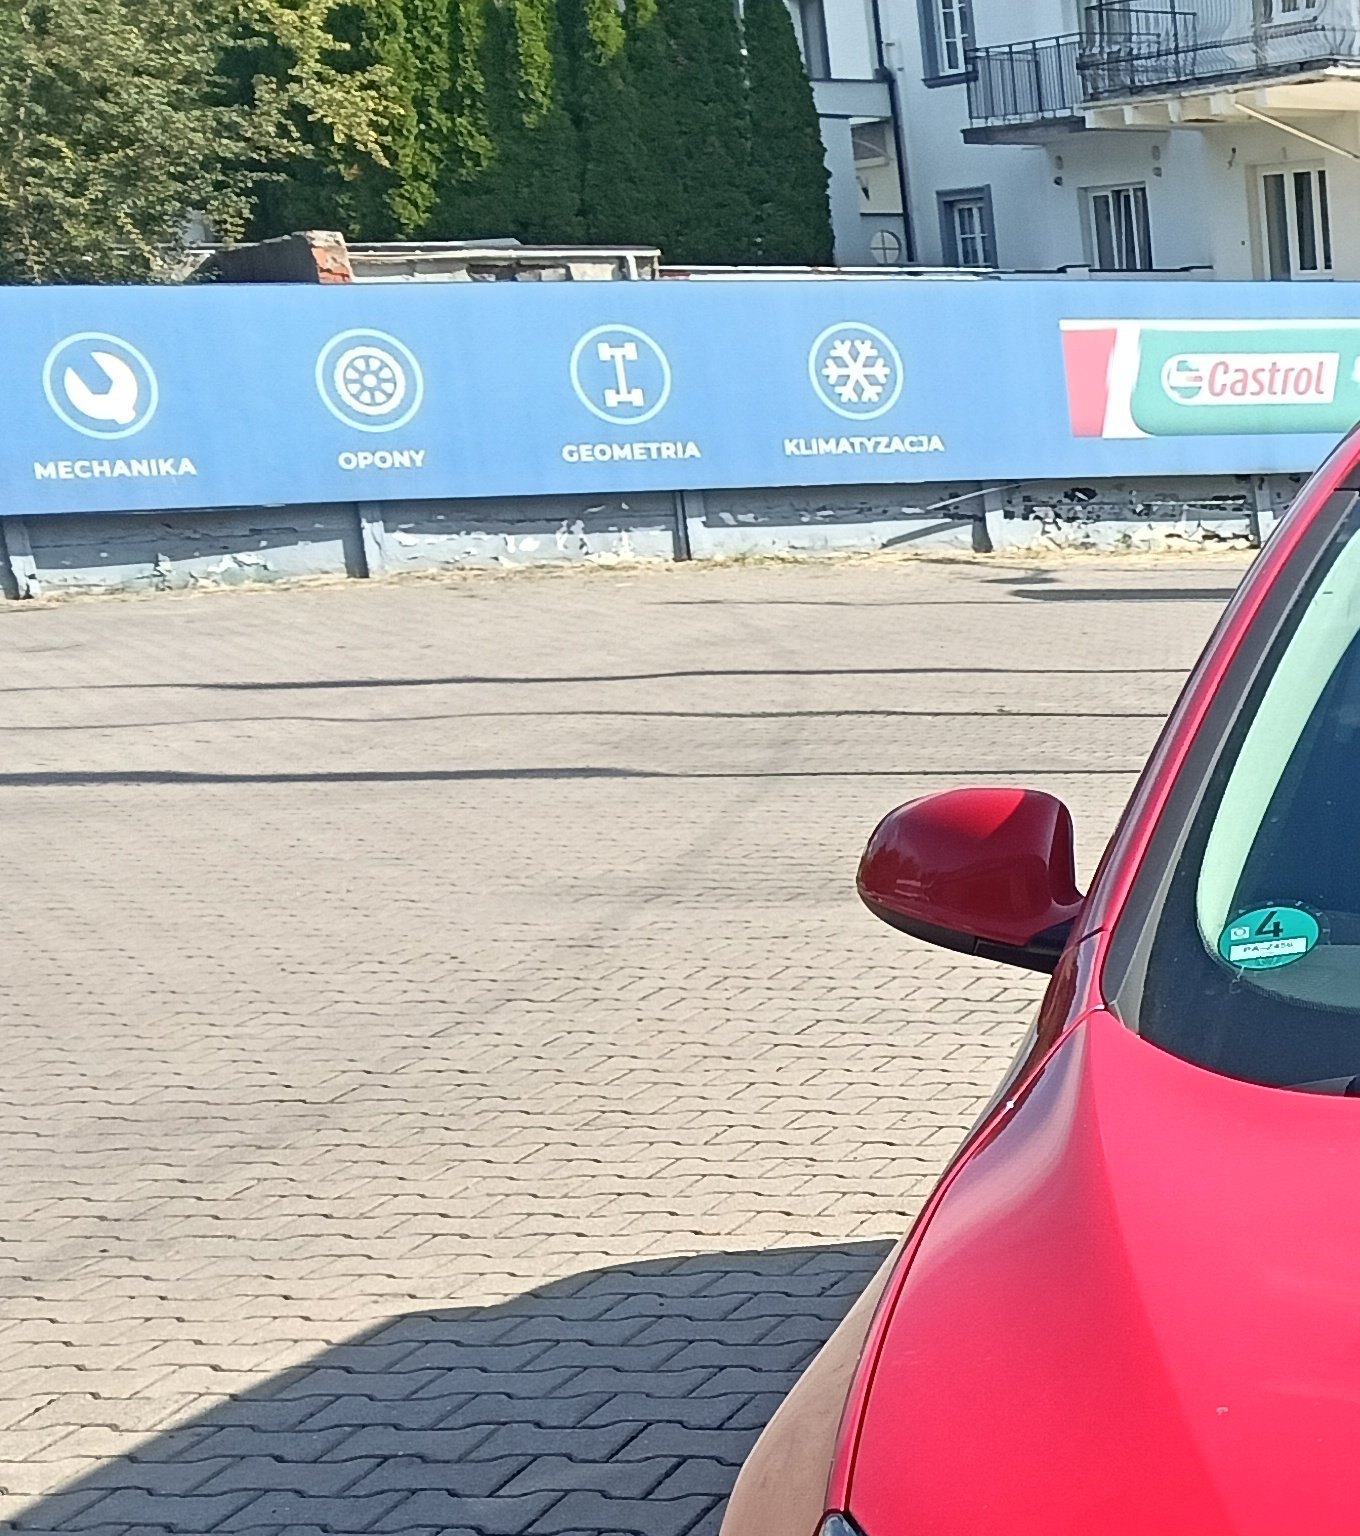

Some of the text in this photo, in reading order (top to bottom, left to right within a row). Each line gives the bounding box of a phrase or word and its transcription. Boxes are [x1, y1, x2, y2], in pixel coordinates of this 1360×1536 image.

[1207, 361, 1325, 397] Castrol
[561, 441, 702, 463] GEOMETRIA
[783, 434, 945, 456] KLIMATYZACJA
[34, 457, 197, 480] MECHANIKA
[338, 449, 426, 471] OPONY
[1254, 911, 1284, 938] 4
